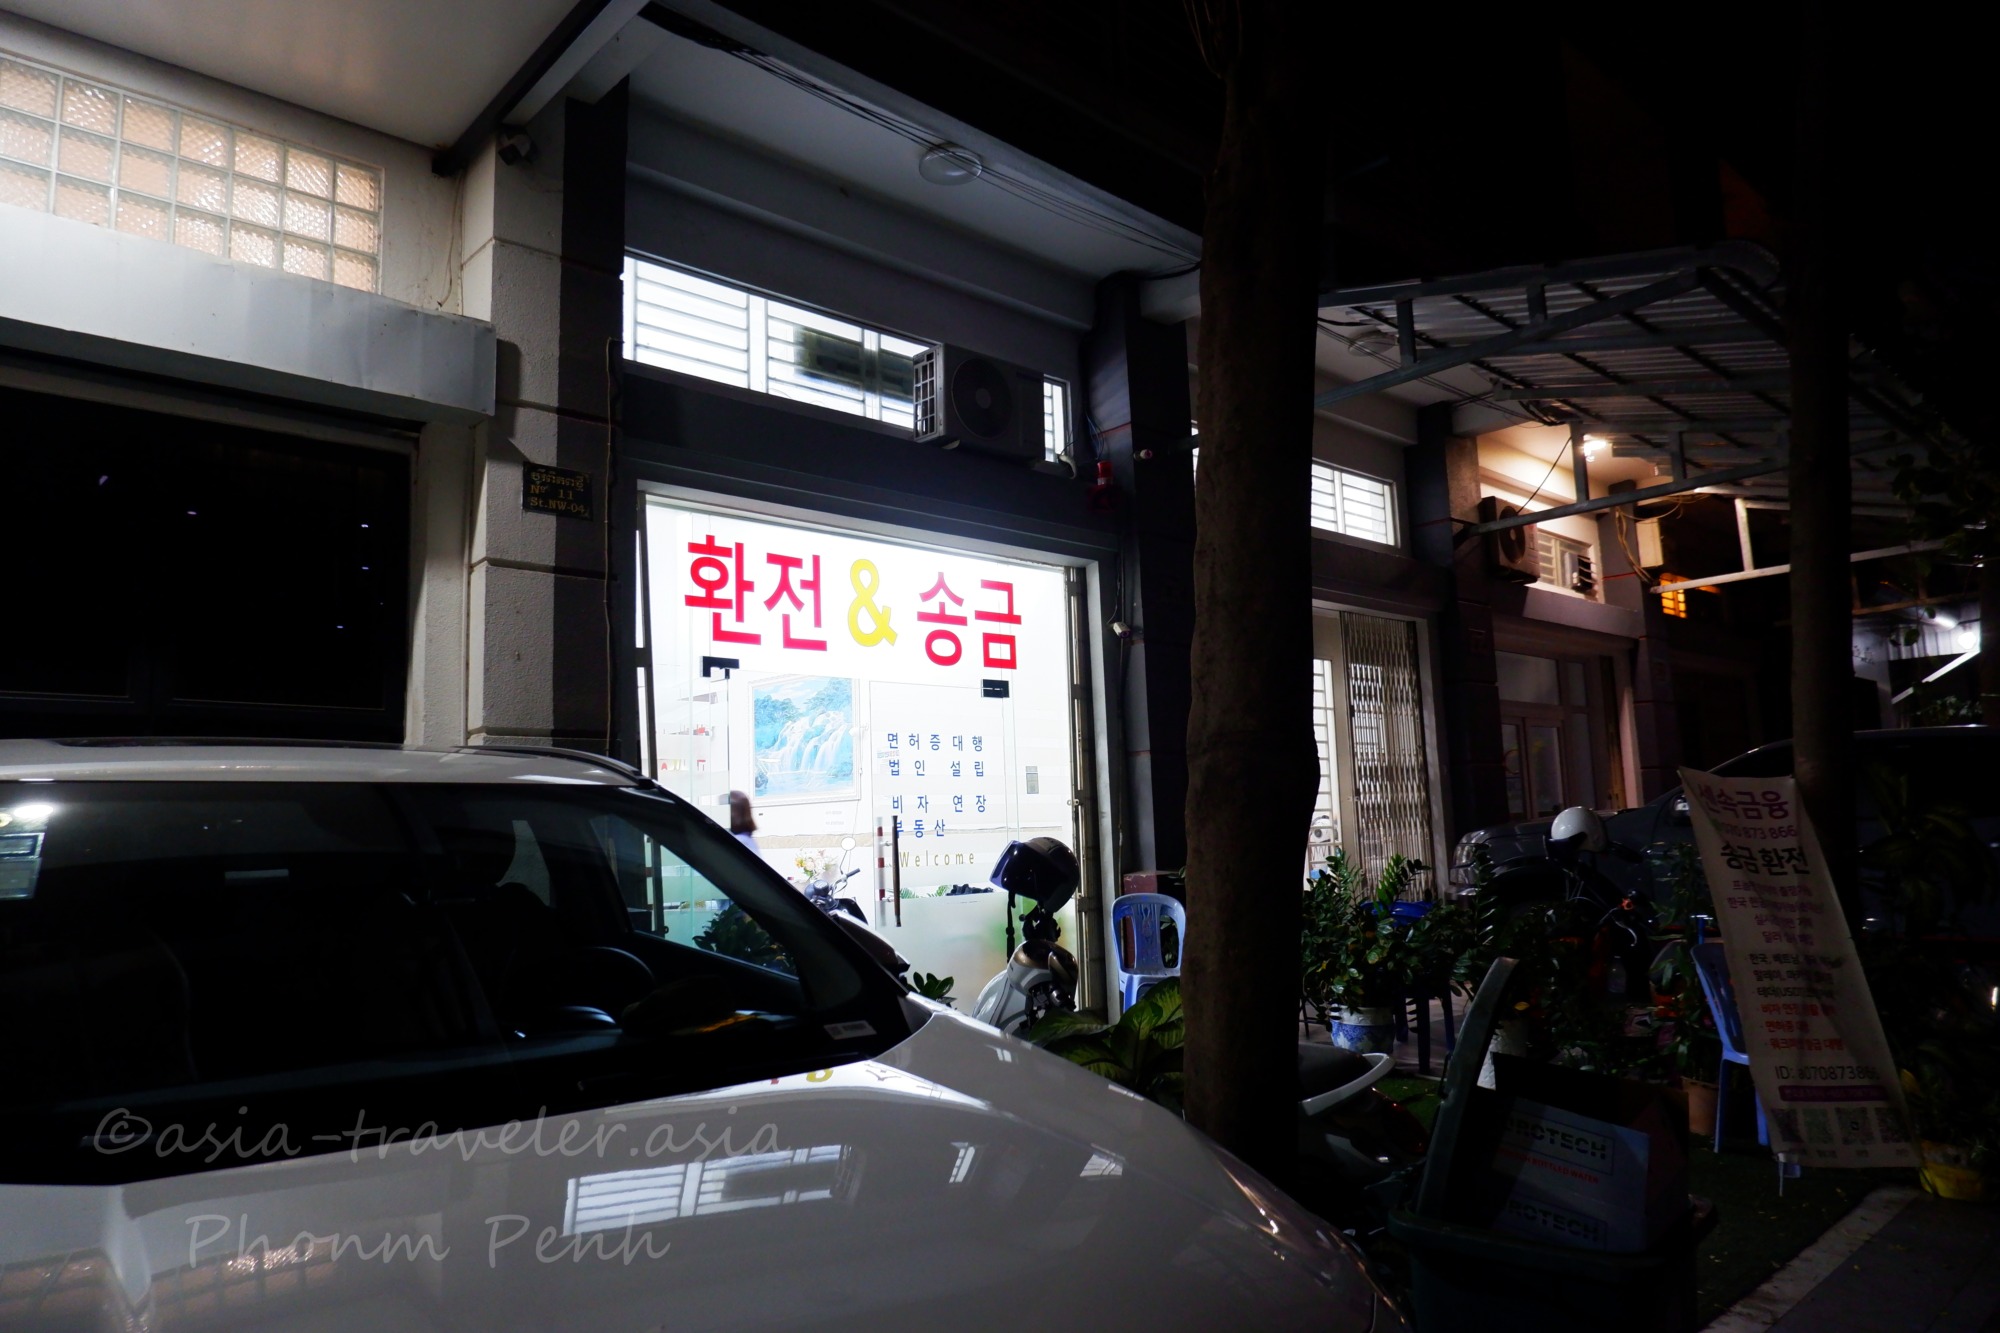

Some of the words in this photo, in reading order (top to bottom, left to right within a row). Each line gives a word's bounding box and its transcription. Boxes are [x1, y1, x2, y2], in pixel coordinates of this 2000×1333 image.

[558, 489, 574, 500] 11
[684, 534, 828, 652] 환전
[847, 558, 898, 647] &
[917, 571, 1022, 670] 송금
[888, 759, 926, 776] 법인
[950, 760, 984, 777] 설립
[892, 794, 929, 814] 비자
[952, 794, 987, 813] 연장
[899, 850, 975, 868] Welcome
[1775, 1065, 1795, 1079] ID:
[1570, 1169, 1599, 1184] WATER
